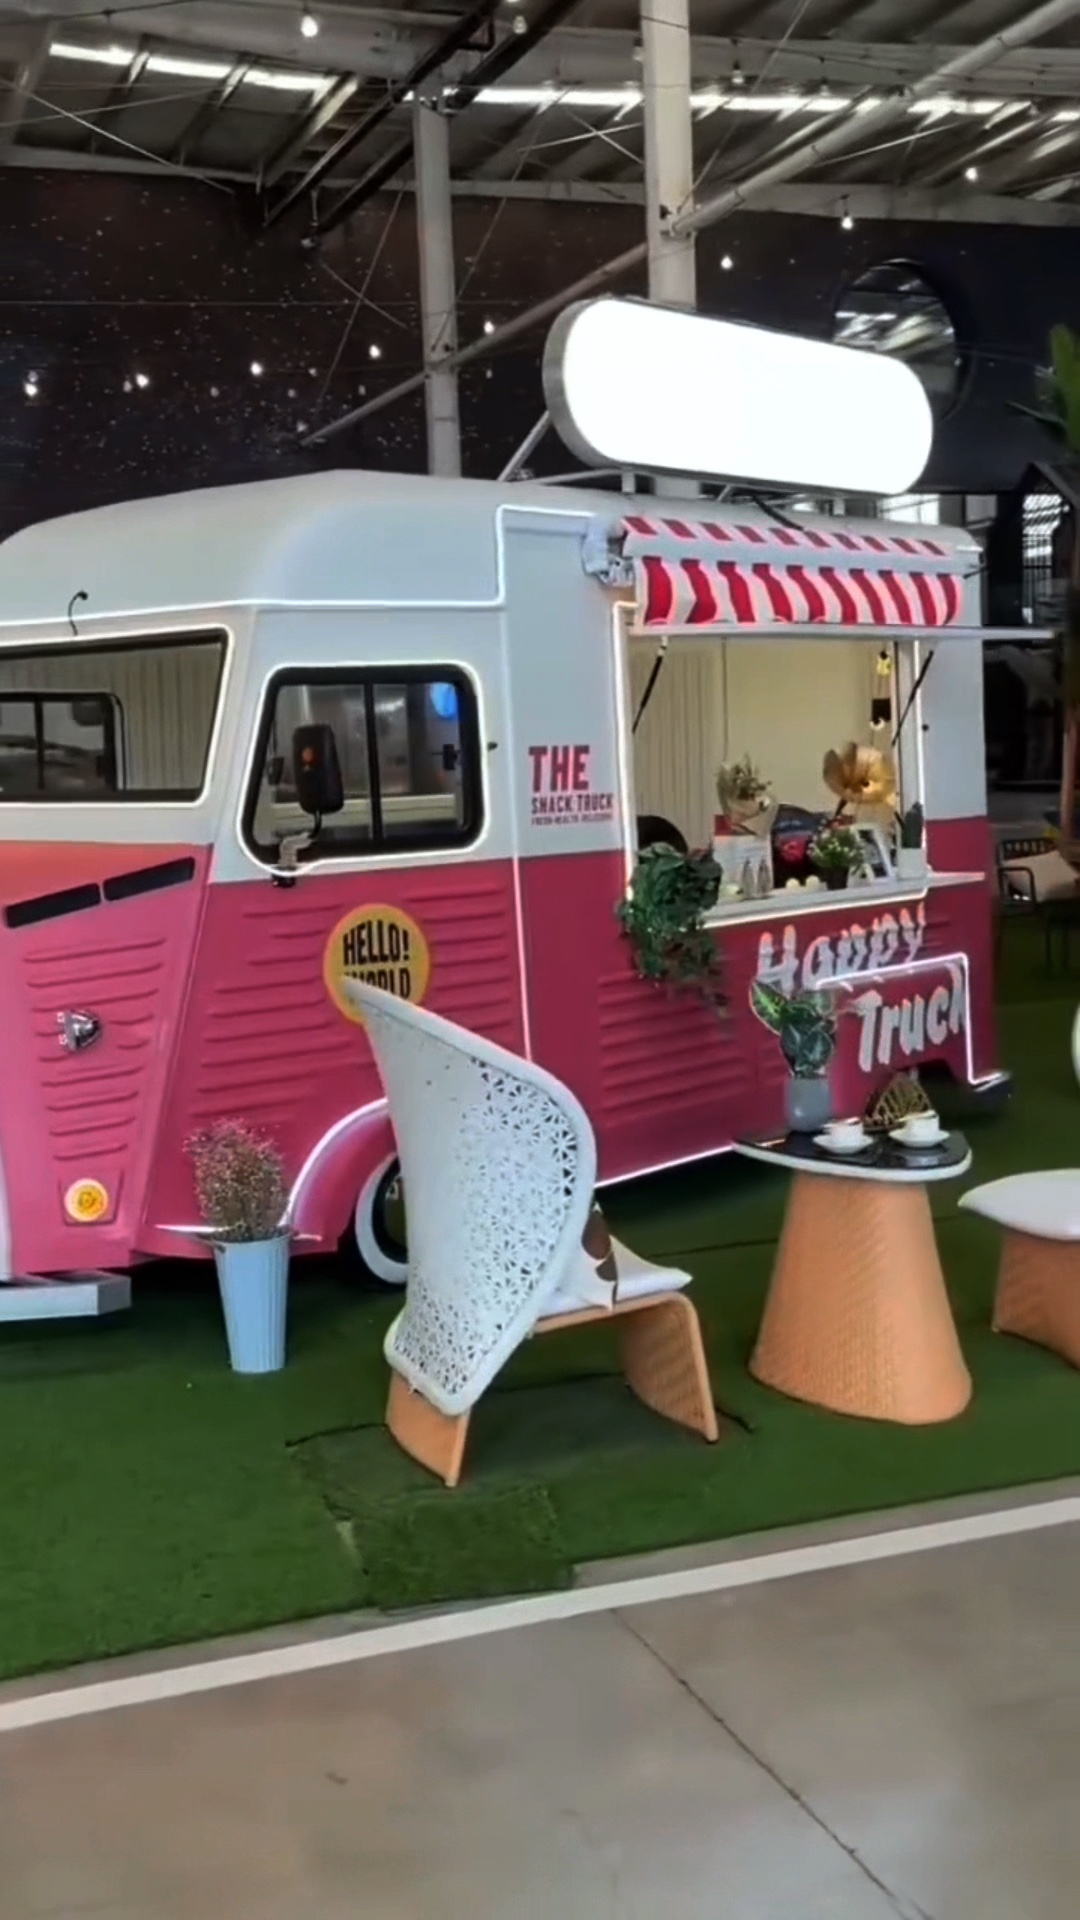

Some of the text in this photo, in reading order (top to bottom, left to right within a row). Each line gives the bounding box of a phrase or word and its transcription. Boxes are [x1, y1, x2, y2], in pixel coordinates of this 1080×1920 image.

[529, 745, 589, 792] THE
[577, 793, 613, 811] TRUCK
[343, 919, 409, 966] HELLO!
